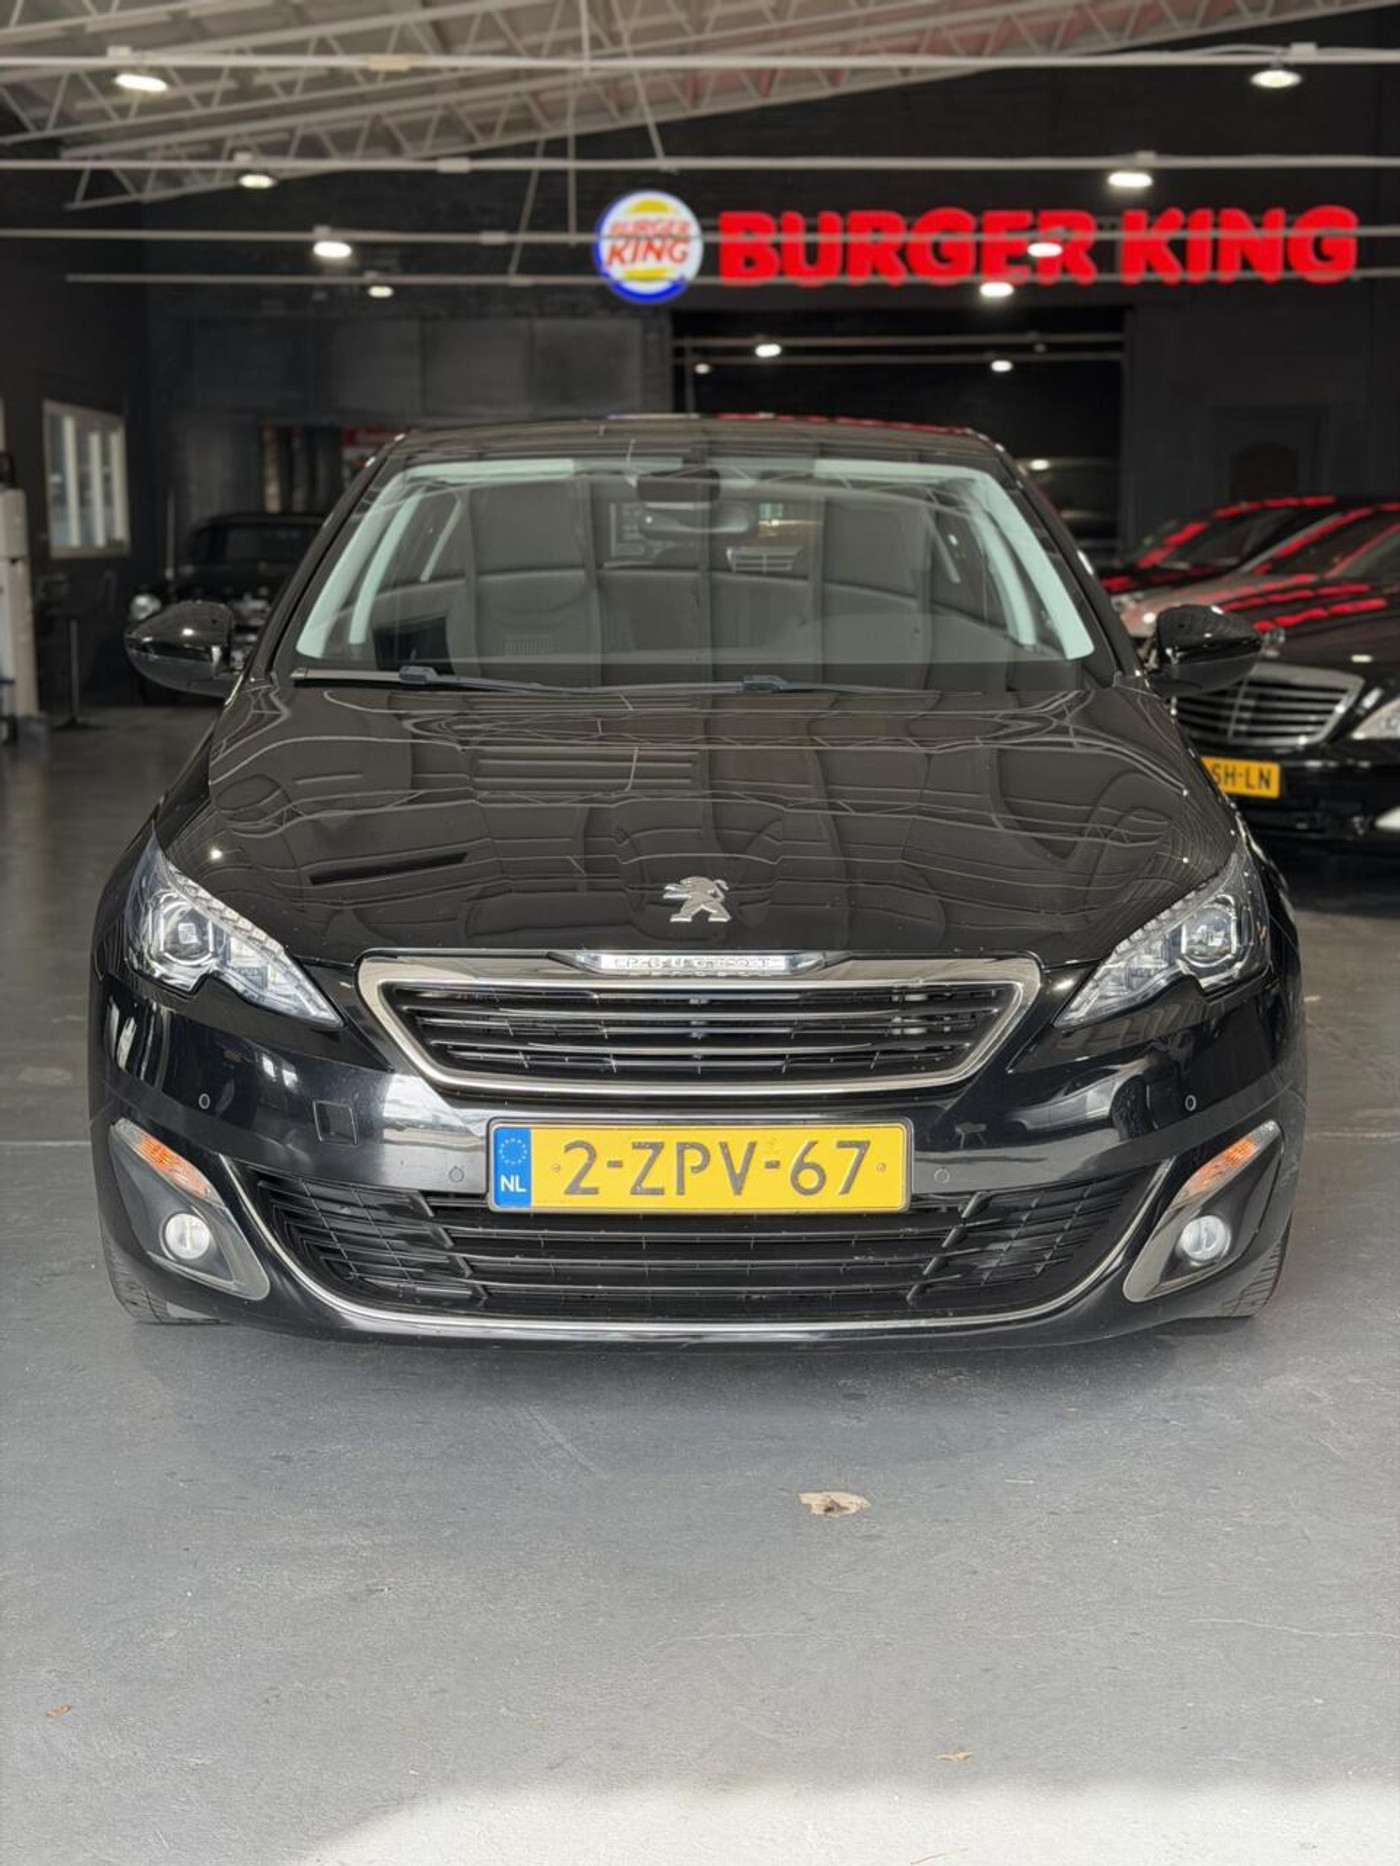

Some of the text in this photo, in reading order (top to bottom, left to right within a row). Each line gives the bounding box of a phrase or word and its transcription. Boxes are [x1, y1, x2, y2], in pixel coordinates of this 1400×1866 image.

[605, 234, 690, 266] KING
[717, 205, 1359, 287] BURGER KING
[500, 1174, 527, 1193] NL
[563, 1139, 871, 1196] 2-ZPV-67
